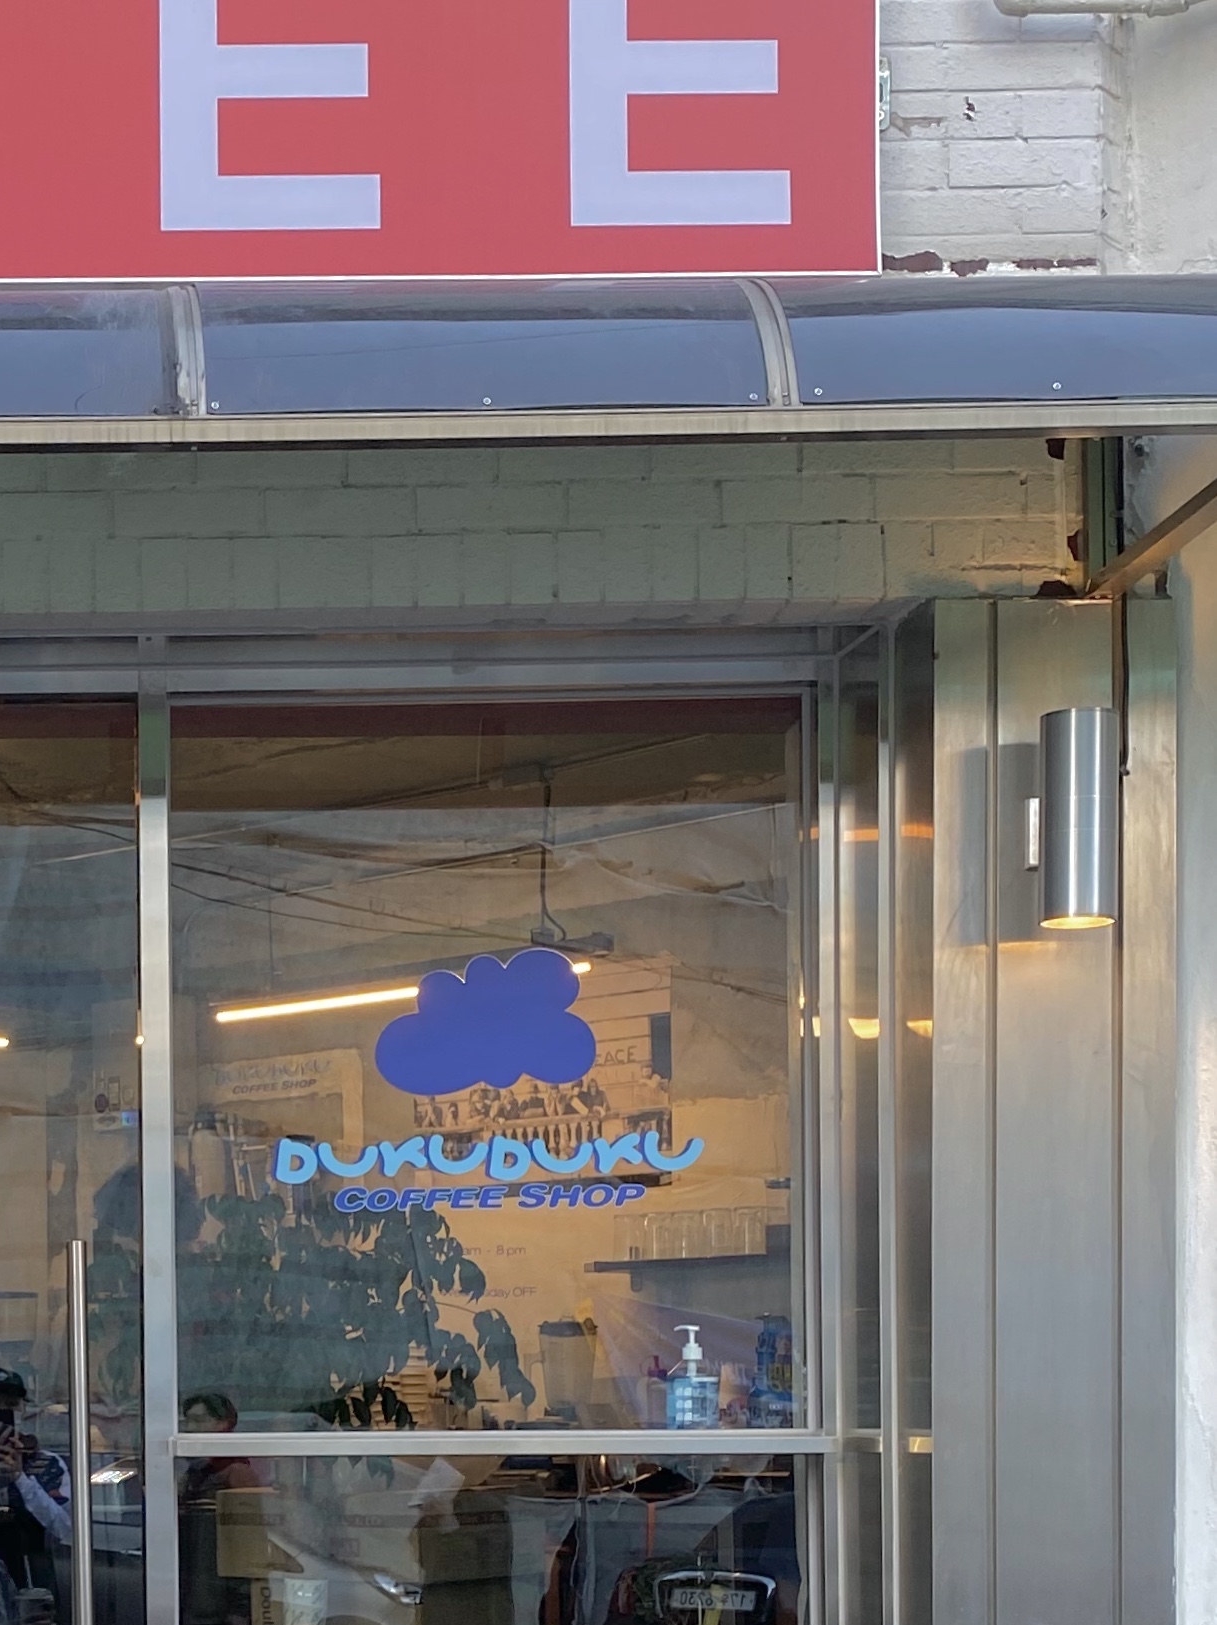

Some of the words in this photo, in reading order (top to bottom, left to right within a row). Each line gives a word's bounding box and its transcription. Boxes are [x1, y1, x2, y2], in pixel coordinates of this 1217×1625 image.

[596, 1045, 638, 1066] ACE
[232, 1082, 279, 1095] COFFEE
[282, 1078, 317, 1091] SHOP
[275, 1130, 705, 1185] DUKUDUKU
[333, 1185, 509, 1213] COFFEE
[517, 1182, 647, 1209] SHOP
[512, 1286, 537, 1298] OFF
